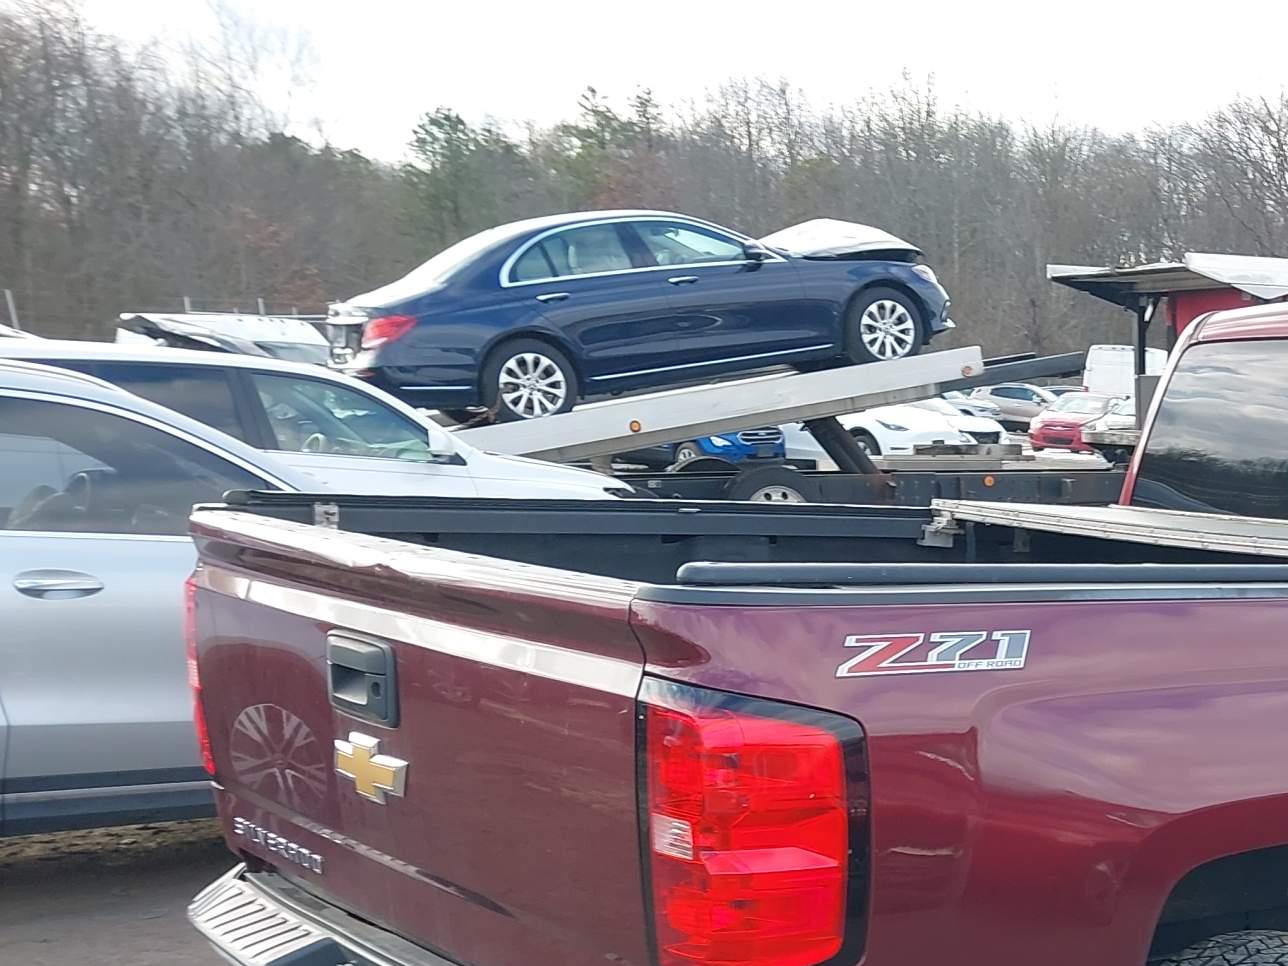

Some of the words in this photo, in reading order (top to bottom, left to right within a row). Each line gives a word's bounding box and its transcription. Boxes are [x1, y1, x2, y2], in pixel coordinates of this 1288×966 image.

[835, 629, 1031, 678] Z71
[957, 661, 985, 669] OFF
[988, 659, 1022, 668] ROAD
[233, 817, 323, 874] SILVERADO
